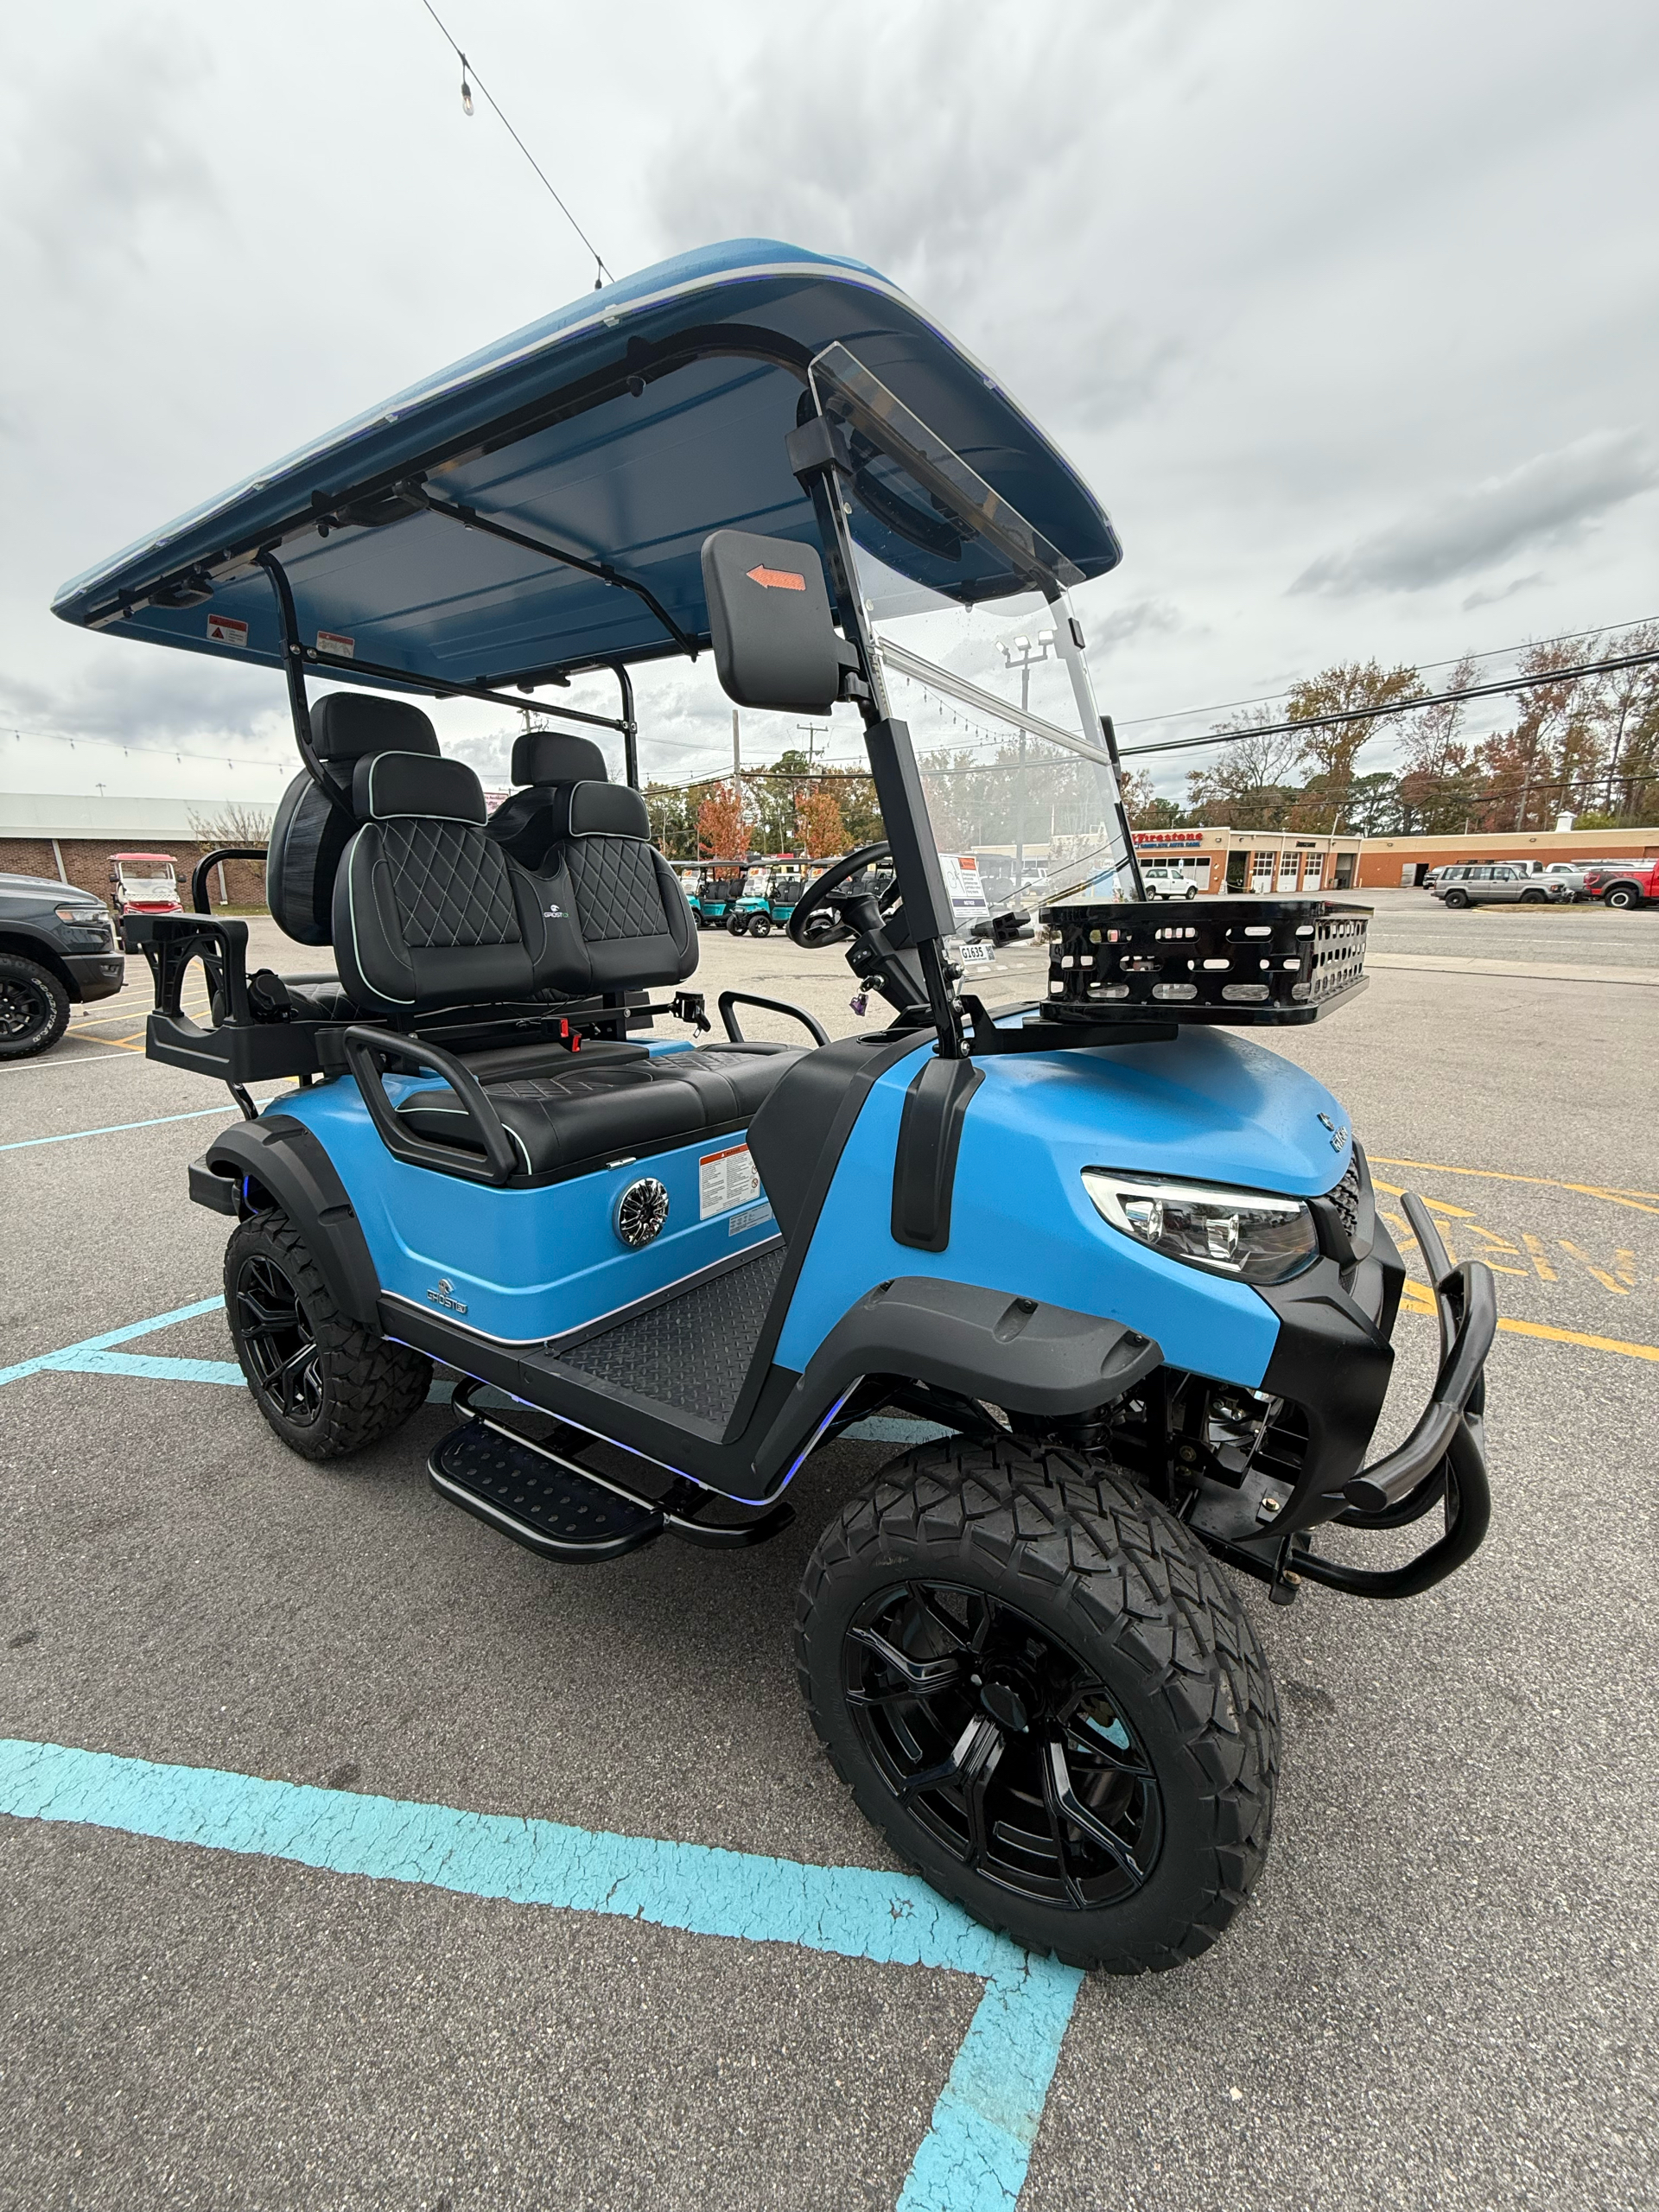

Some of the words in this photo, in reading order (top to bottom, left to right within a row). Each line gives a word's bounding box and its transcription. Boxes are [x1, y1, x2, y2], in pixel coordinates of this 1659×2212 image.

[1132, 833, 1202, 843] Firestone
[961, 946, 984, 958] G1635
[31, 977, 58, 1043] GOODYEAR
[426, 1288, 458, 1310] GHOST
